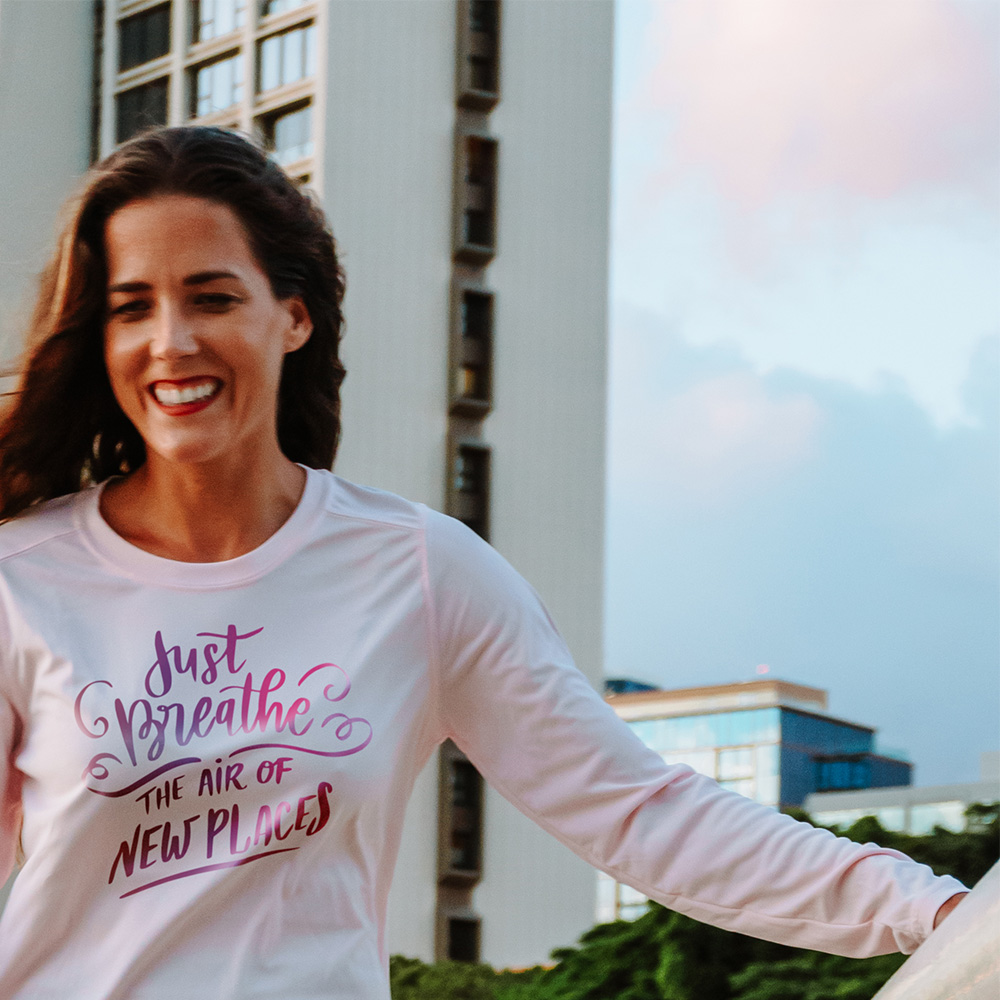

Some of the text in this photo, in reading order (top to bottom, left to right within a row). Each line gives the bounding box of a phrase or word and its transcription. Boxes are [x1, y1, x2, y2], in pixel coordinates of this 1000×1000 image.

[145, 624, 264, 698] Just
[114, 668, 314, 767] Breathe
[135, 775, 186, 815] THE
[256, 757, 293, 785] OF
[108, 781, 333, 885] NEW PLACES
